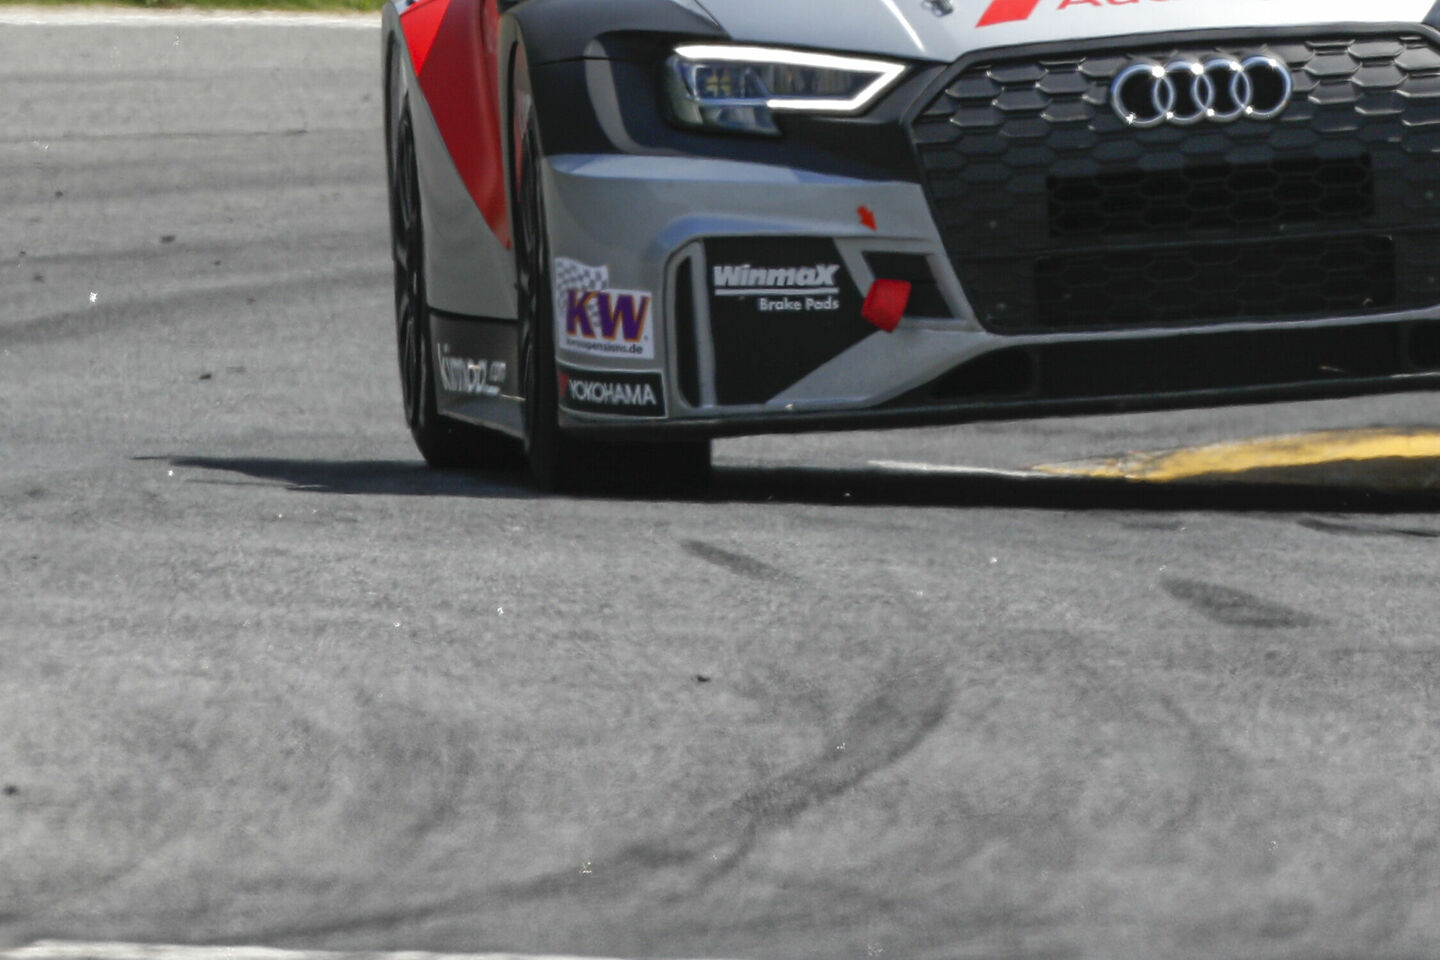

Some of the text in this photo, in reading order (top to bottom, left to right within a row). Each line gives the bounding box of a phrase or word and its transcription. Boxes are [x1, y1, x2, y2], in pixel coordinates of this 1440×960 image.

[566, 288, 651, 343] KW
[758, 296, 840, 311] Brake Pads
[568, 379, 657, 405] YOKOHAMA
